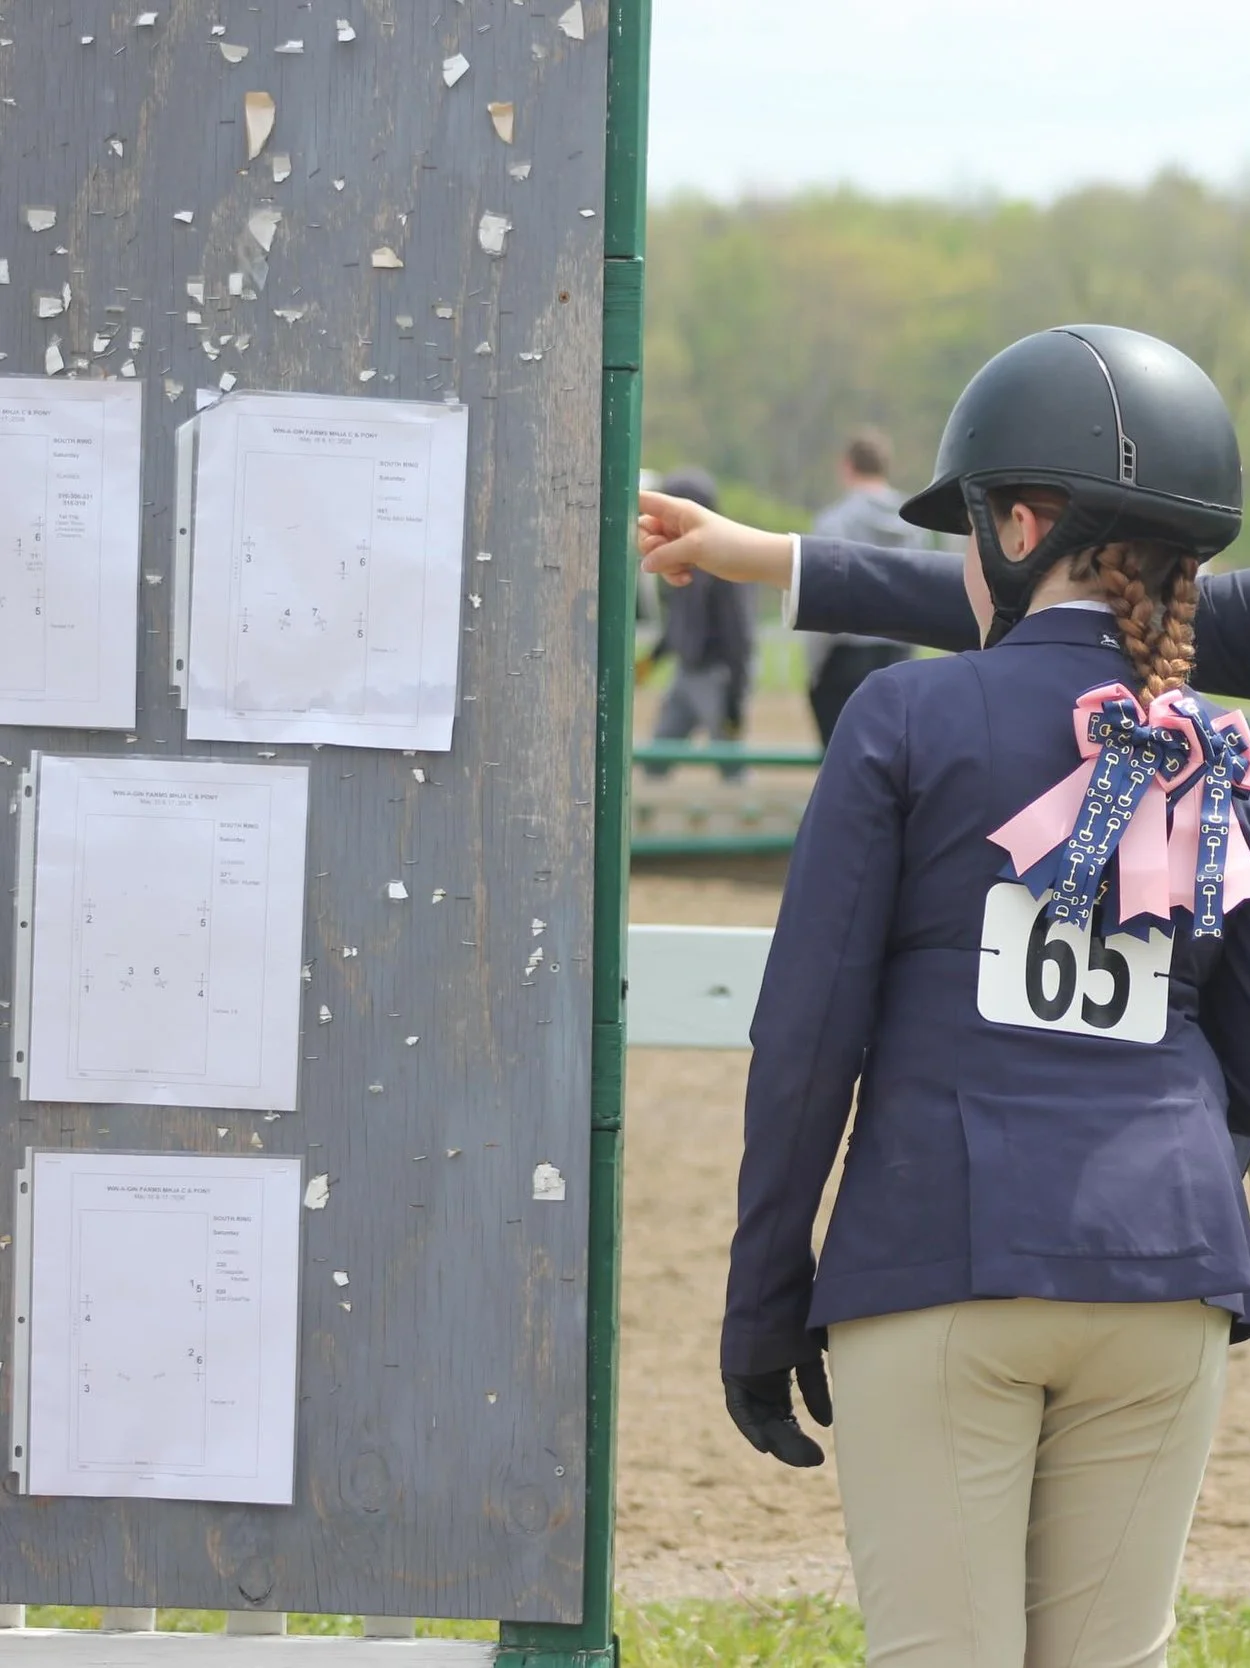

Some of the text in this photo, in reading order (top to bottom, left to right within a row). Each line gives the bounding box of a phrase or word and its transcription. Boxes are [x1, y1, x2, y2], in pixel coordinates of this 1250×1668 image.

[35, 533, 41, 542] 6
[245, 554, 252, 563] 3
[359, 557, 366, 567] 6
[35, 606, 41, 616] 5
[284, 608, 291, 617] 4
[312, 607, 318, 617] 7
[242, 623, 249, 633] 2
[86, 914, 93, 924] 2
[1026, 902, 1130, 1029] 65
[128, 966, 134, 976] 3
[153, 966, 160, 976] 6
[198, 989, 204, 998] 4
[196, 1284, 202, 1293] 5
[85, 1314, 92, 1323] 4
[188, 1348, 194, 1357] 2
[197, 1355, 203, 1365] 6
[84, 1384, 91, 1393] 3
